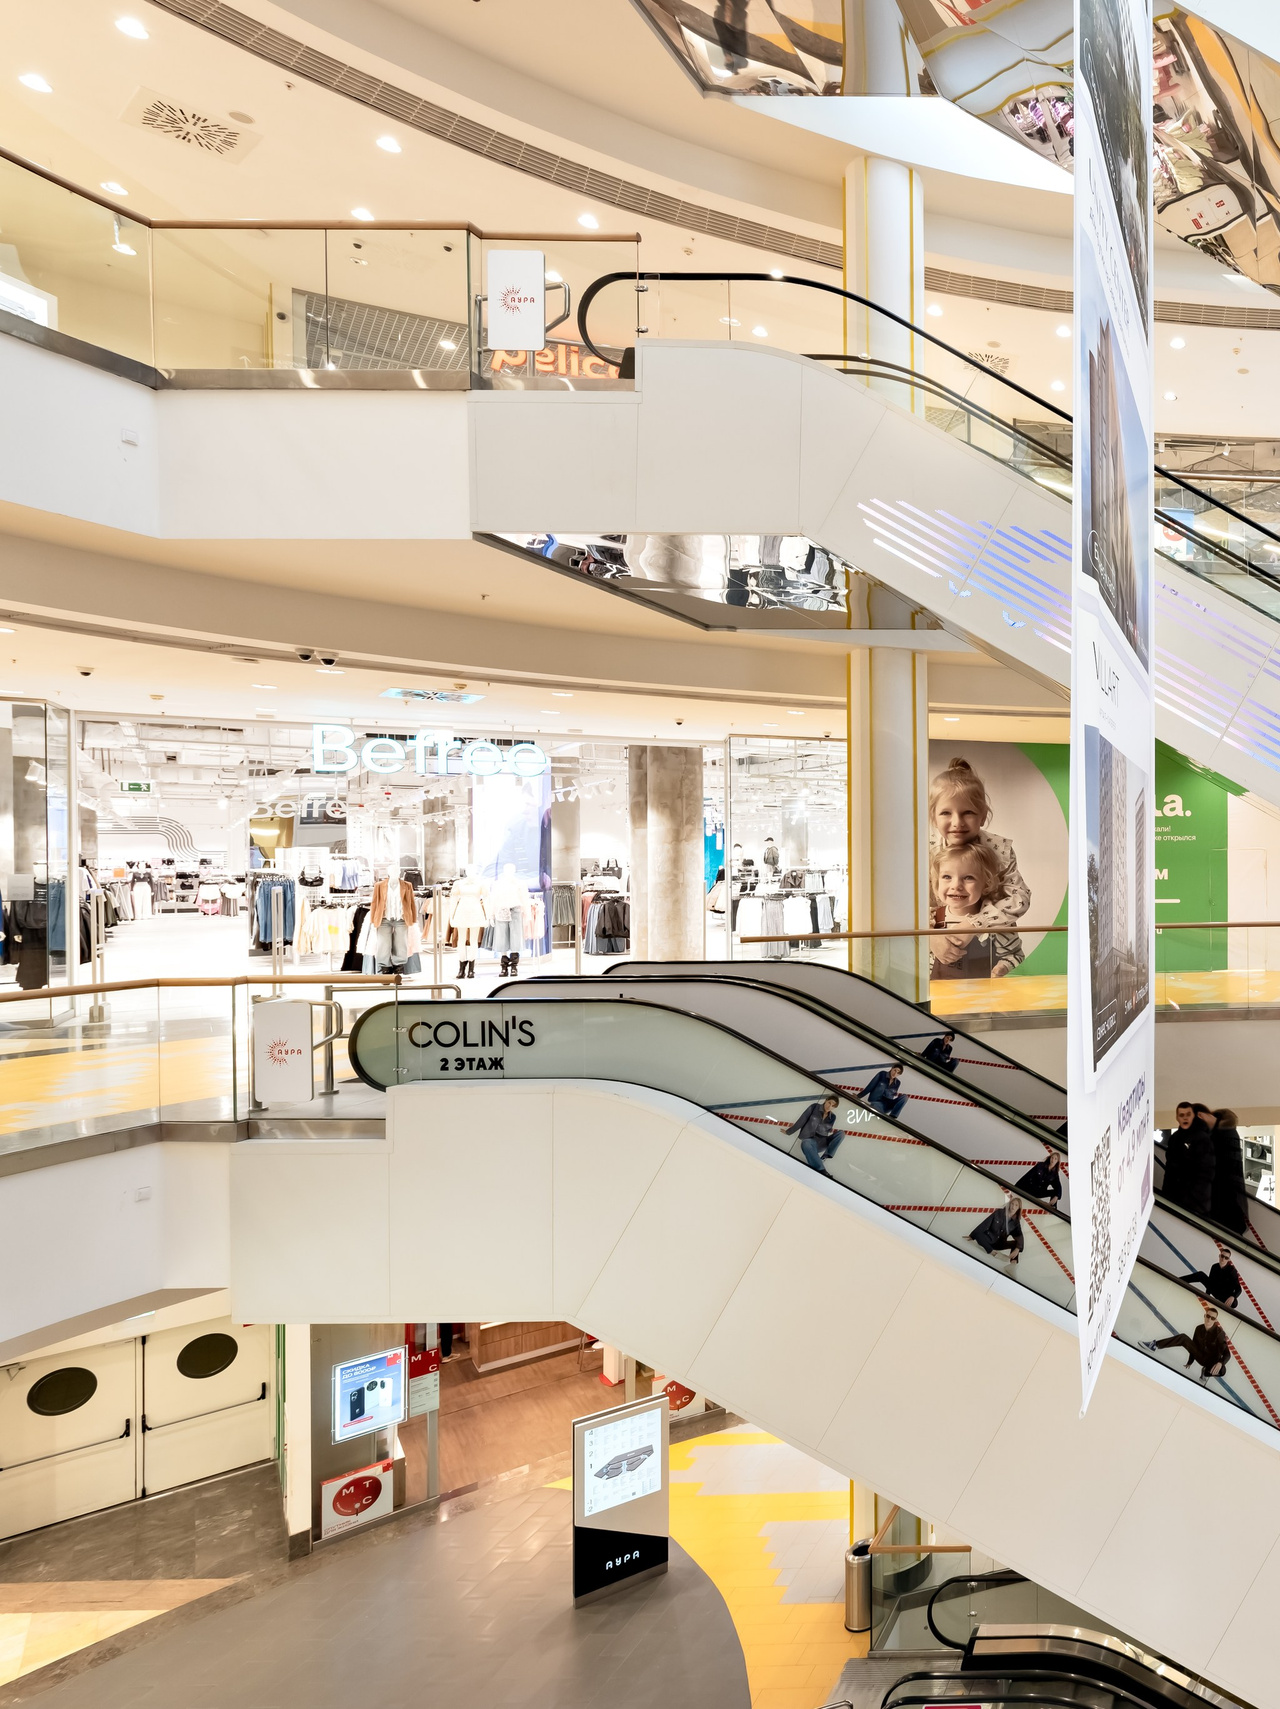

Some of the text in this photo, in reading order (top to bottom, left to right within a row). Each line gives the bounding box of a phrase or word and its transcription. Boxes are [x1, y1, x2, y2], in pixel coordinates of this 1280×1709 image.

[312, 723, 547, 777] Befree
[408, 1016, 536, 1048] COLIN'S
[277, 1048, 302, 1056] АУРА
[440, 1057, 504, 1071] 2 ЭТАЖ
[605, 1550, 640, 1570] АУРА
